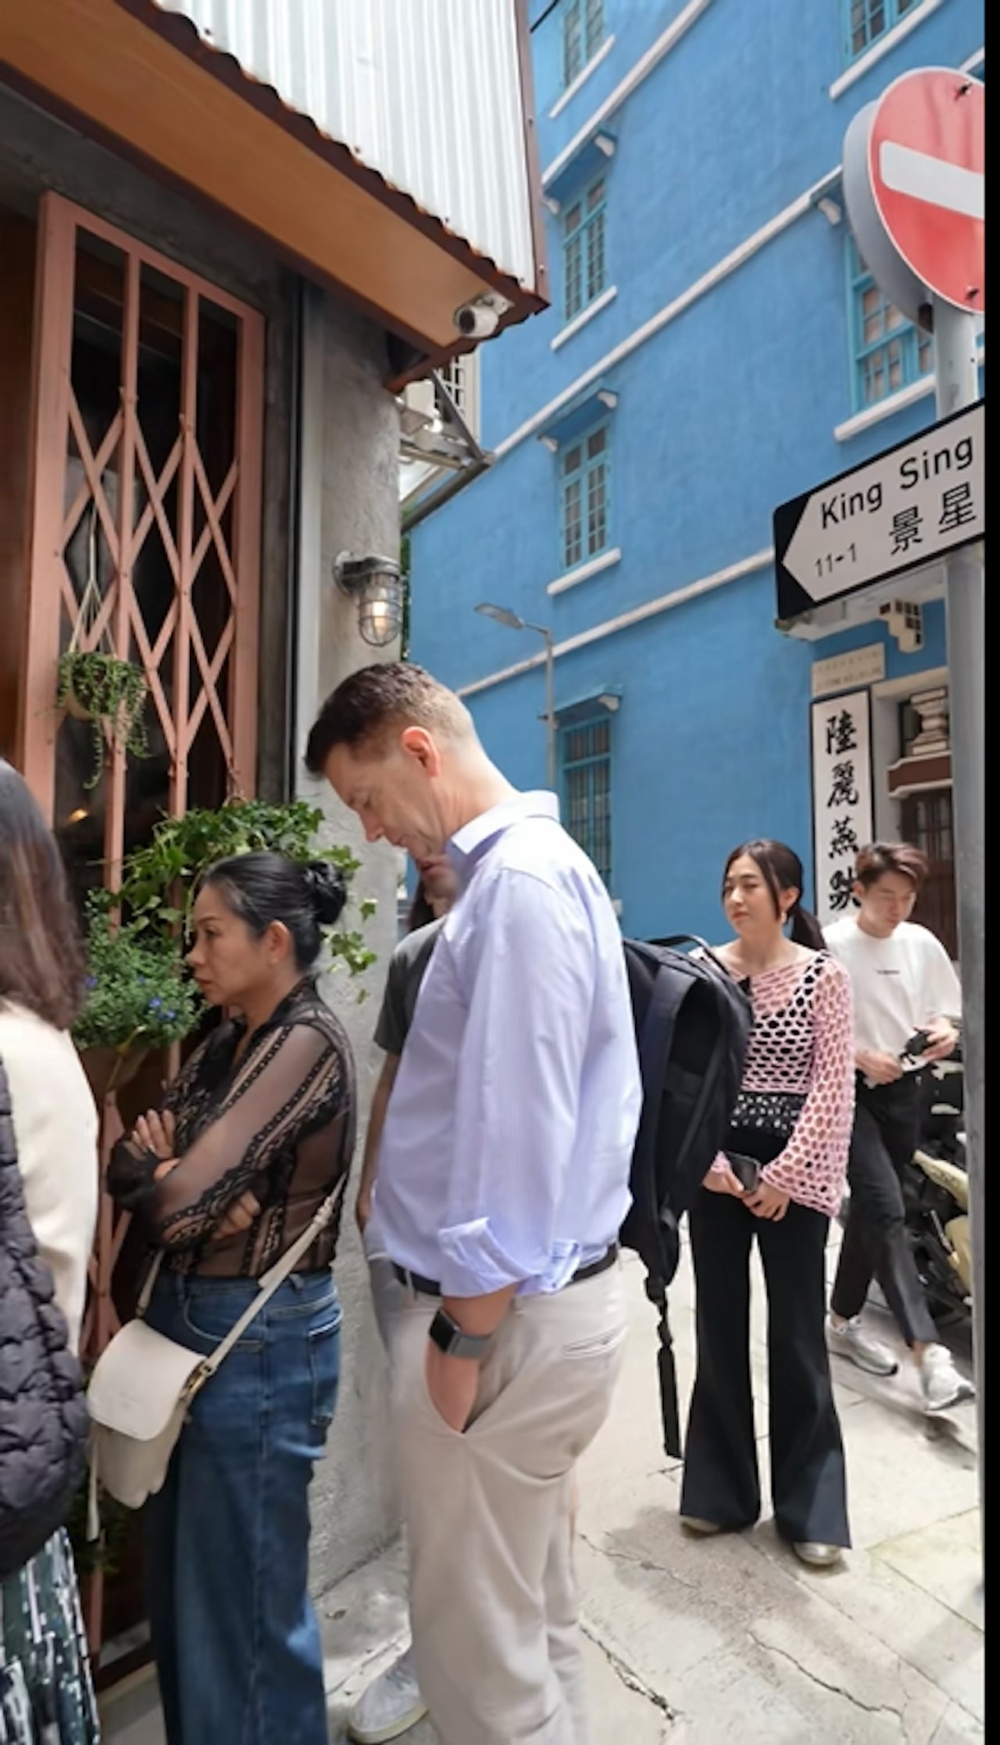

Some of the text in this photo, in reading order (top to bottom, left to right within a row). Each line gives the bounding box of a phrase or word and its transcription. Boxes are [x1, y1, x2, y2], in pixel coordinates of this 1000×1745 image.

[820, 436, 974, 530] King Sing
[888, 481, 978, 556] 景星
[814, 543, 858, 578] 11-1
